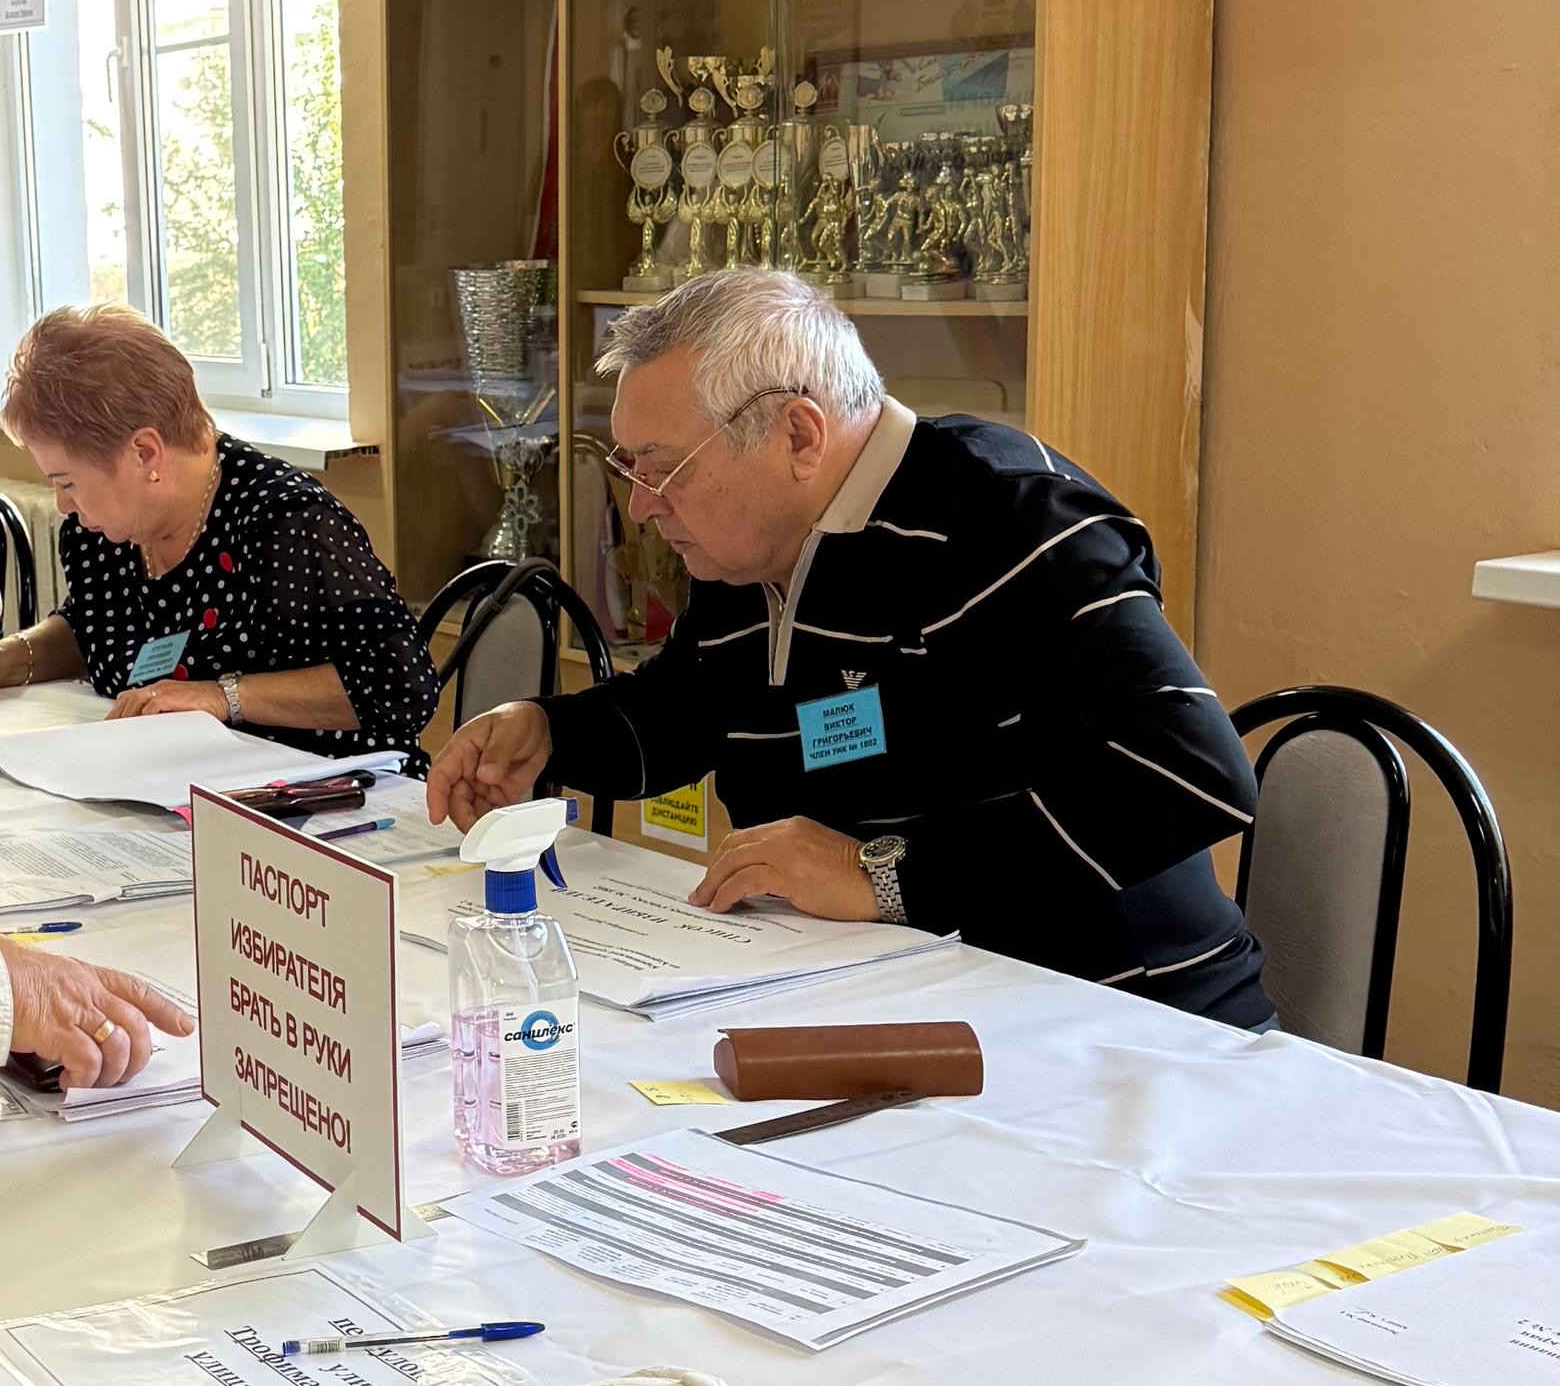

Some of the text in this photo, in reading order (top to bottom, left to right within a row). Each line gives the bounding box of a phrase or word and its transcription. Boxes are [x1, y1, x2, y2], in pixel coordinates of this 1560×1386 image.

[823, 703, 855, 718] МАЛЮК
[824, 717, 857, 731] ВИКТОР
[812, 726, 873, 749] ГРИГОРЬЕВИЧ
[241, 851, 330, 927] ПАСПОРТ
[230, 917, 347, 1014] ИЗБИРАТЕЛЯ
[230, 976, 352, 1084] БРАТЬ В РУКИ
[504, 1022, 574, 1042] санилекс
[234, 1045, 352, 1154] ЗАПРЕЩЕНО!
